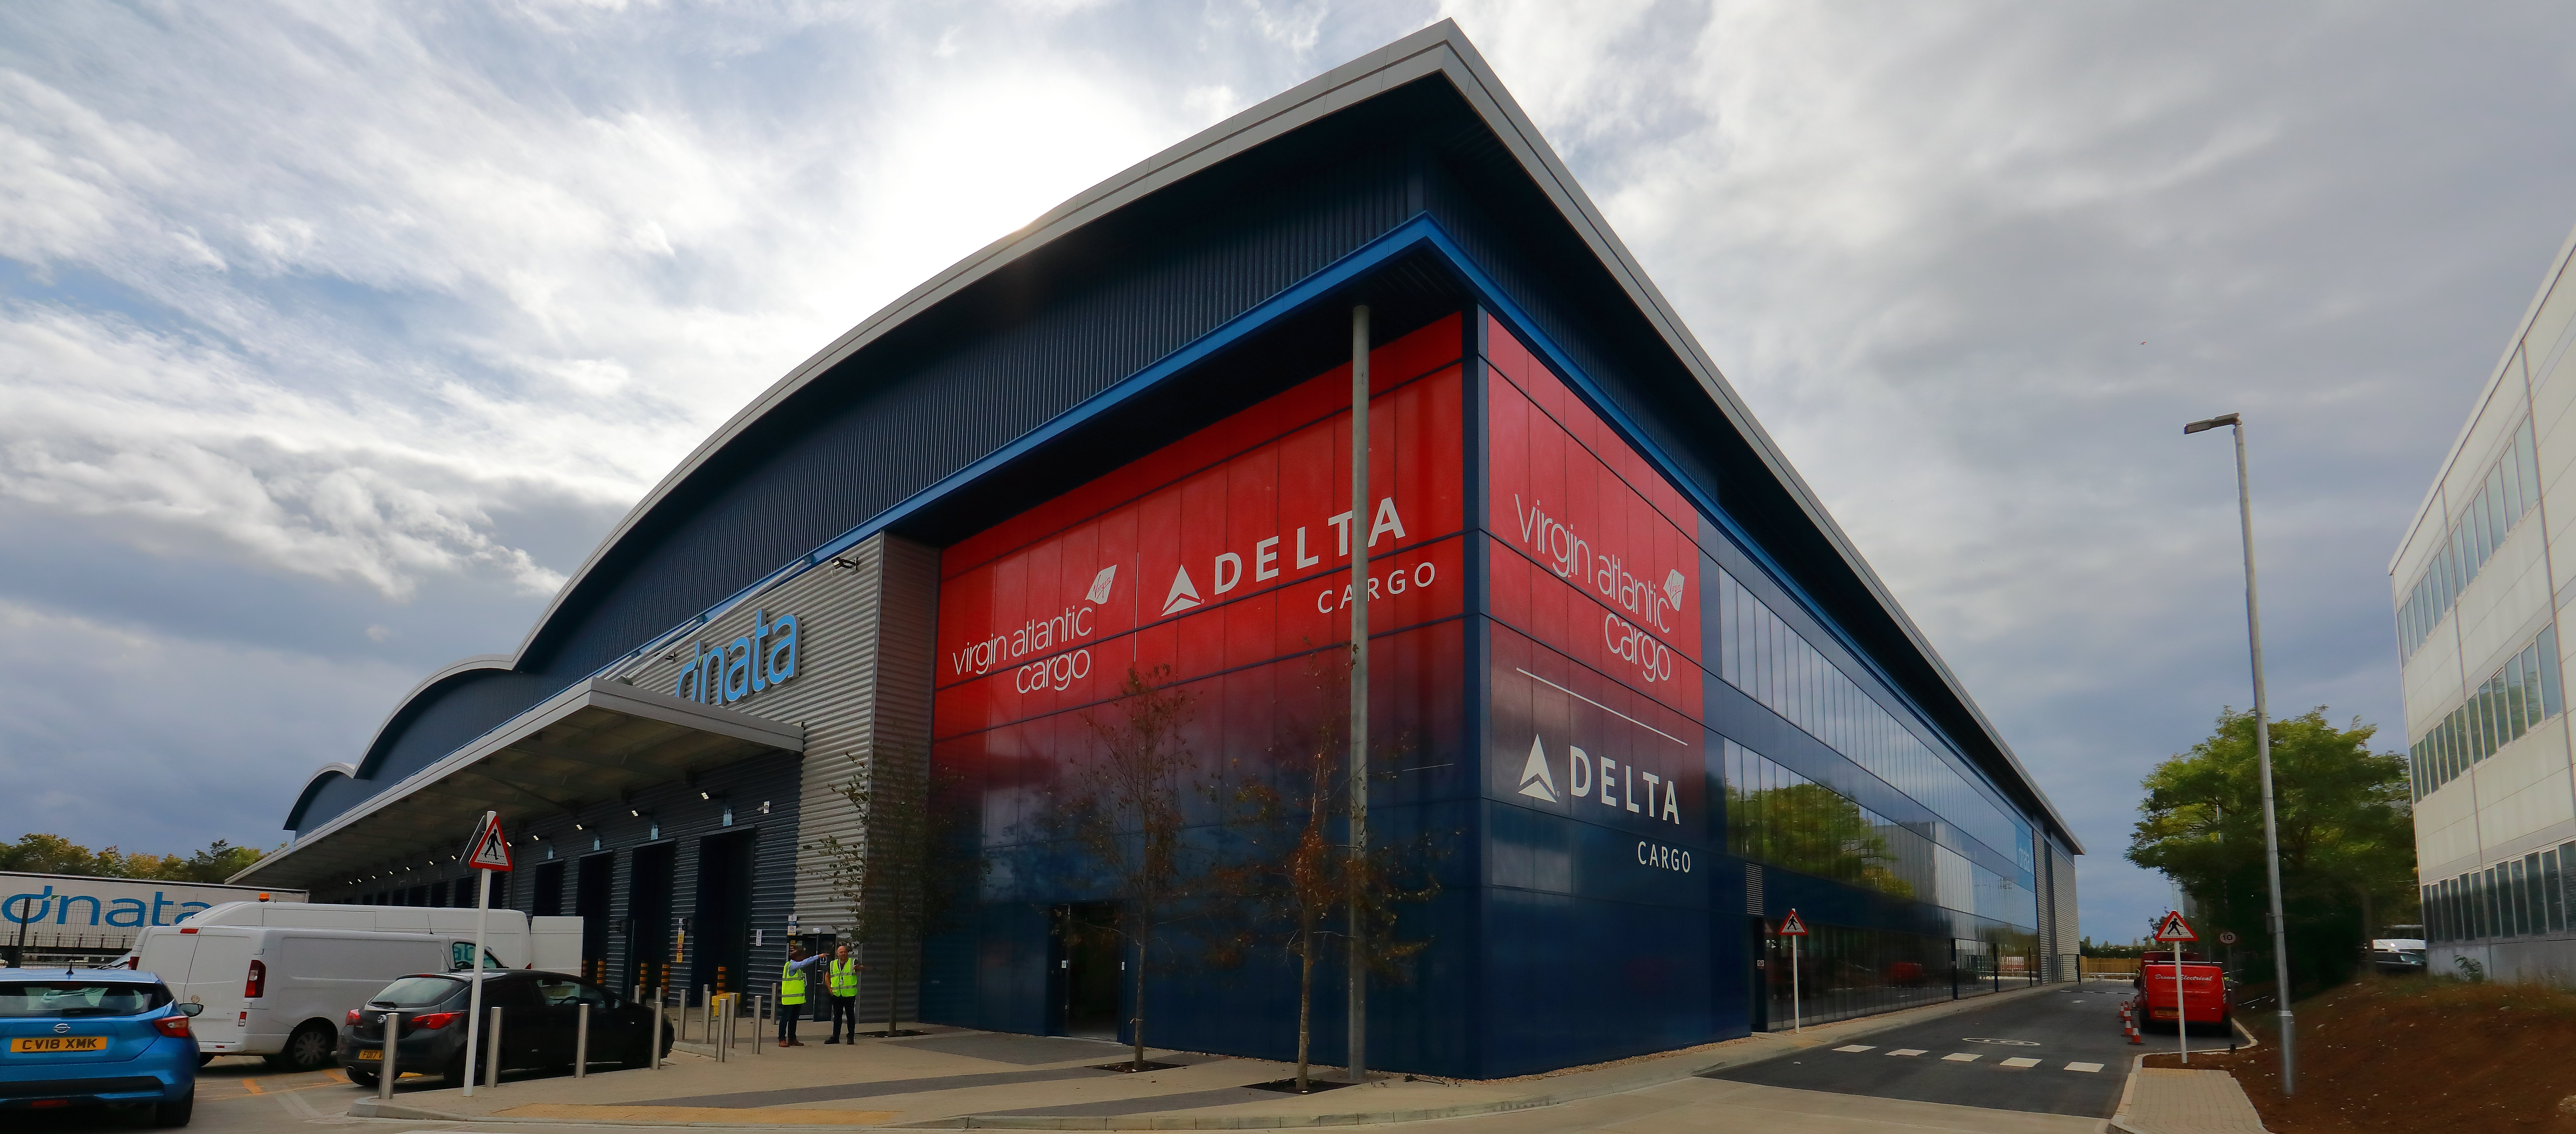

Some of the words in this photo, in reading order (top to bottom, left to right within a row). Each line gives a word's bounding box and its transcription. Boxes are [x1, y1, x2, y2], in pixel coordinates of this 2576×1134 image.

[1214, 497, 1406, 595] DELTA
[1515, 494, 1590, 583] virgin
[1598, 554, 1670, 633] atlantic
[1318, 562, 1435, 613] CARGO
[675, 608, 800, 705] dnata
[953, 633, 1007, 675] virgin
[1012, 605, 1092, 657] atlantic
[1016, 649, 1090, 693] cargo
[1605, 613, 1670, 682] cargo
[1570, 745, 1680, 825] DELTA
[1638, 841, 1690, 873] CARGO
[22, 1040, 60, 1050] CV18
[65, 1038, 97, 1048] XMK
